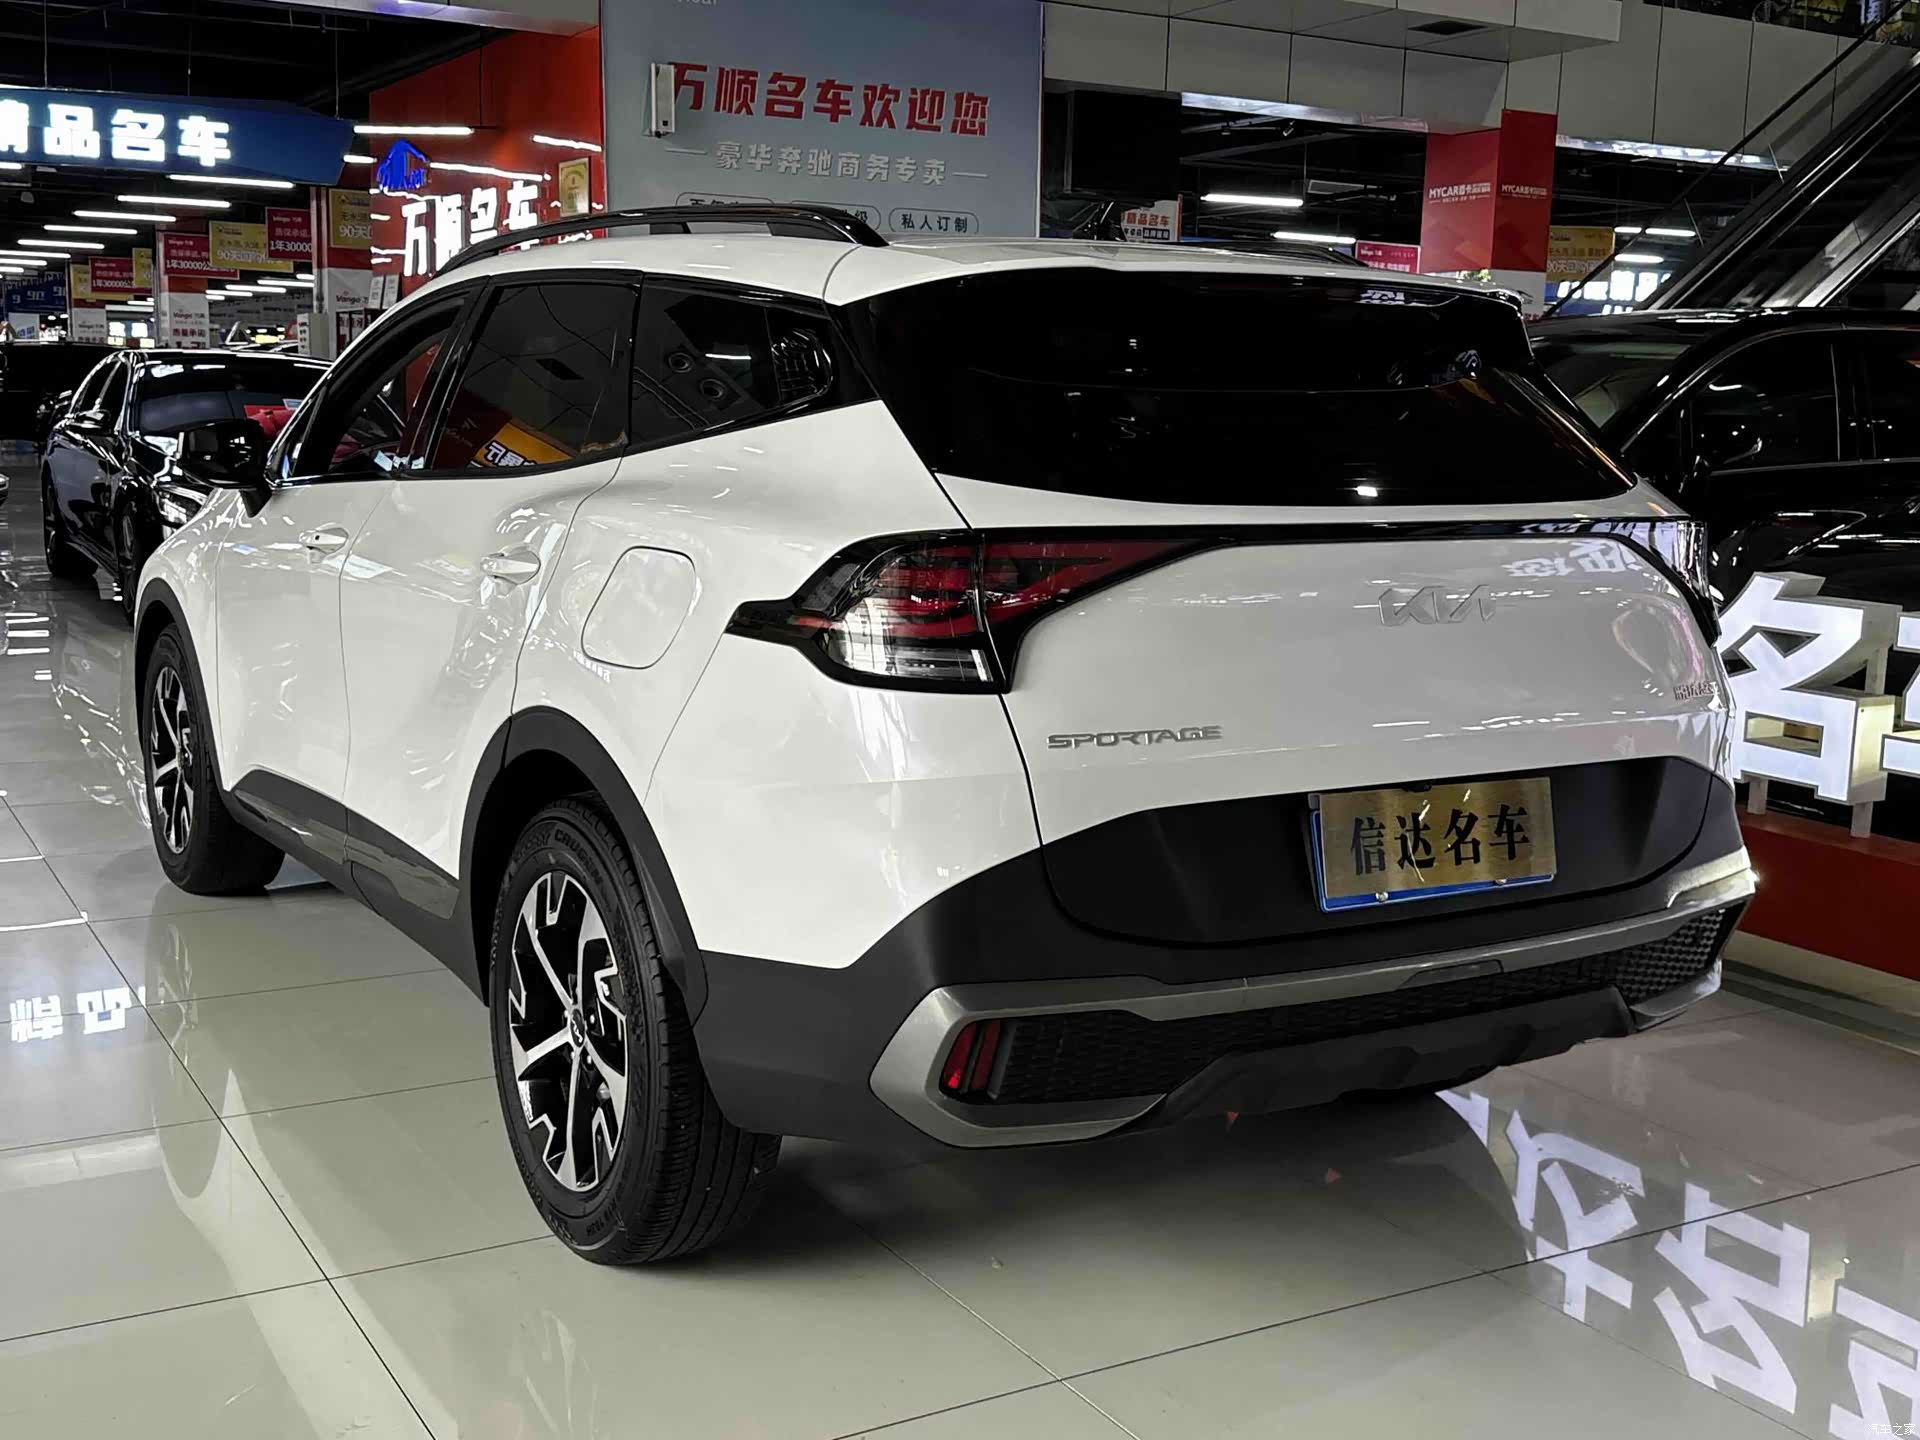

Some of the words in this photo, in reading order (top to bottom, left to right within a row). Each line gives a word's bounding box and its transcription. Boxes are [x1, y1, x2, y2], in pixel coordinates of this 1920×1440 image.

[668, 61, 989, 137] 万顺名车欢迎您
[716, 140, 947, 186] 豪华奔驰商务专卖
[900, 213, 968, 234] 私人订制
[1378, 584, 1497, 627] KIA
[1047, 724, 1224, 750] SPORTAGE
[1350, 803, 1531, 877] 信达名车
